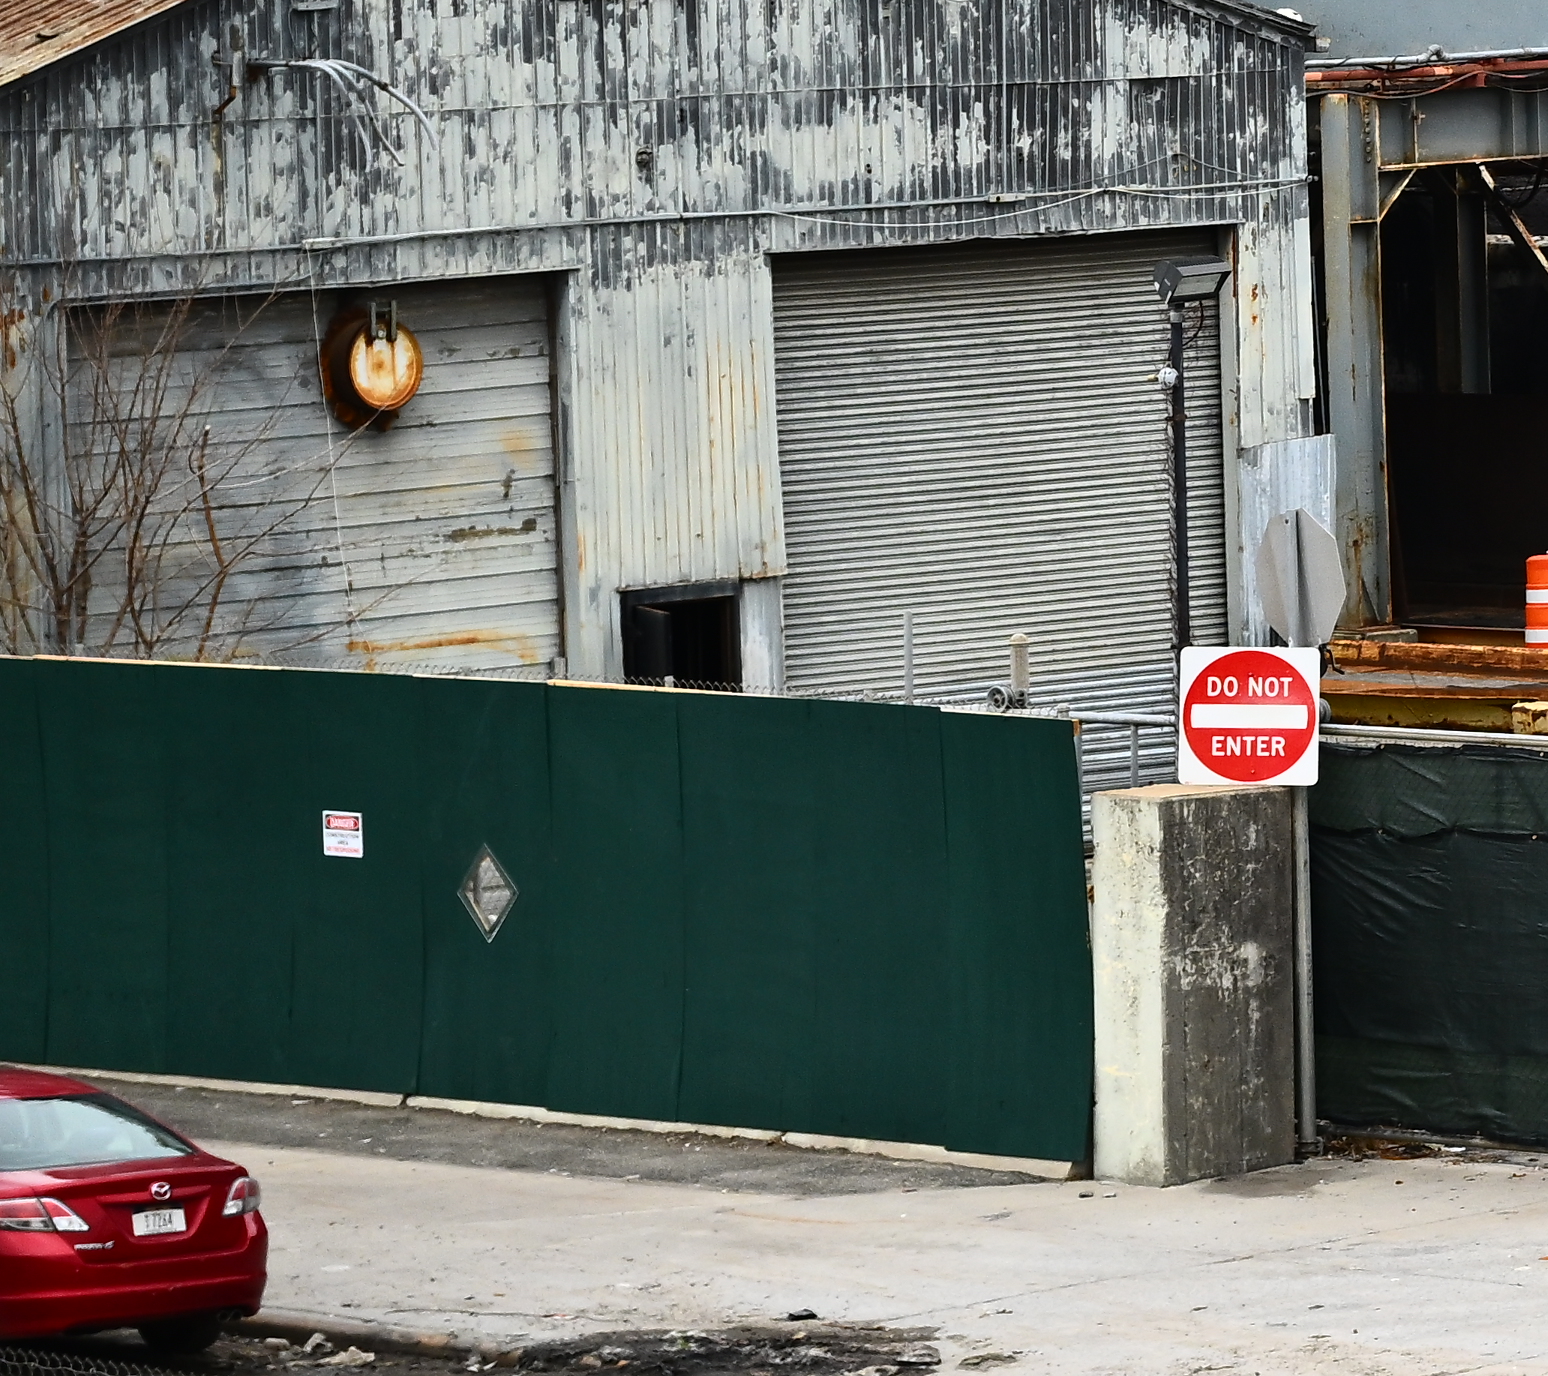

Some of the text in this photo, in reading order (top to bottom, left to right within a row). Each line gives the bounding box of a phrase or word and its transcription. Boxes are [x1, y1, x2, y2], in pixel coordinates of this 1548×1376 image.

[1207, 676, 1293, 697] DO NOT
[1211, 736, 1286, 757] ENTER
